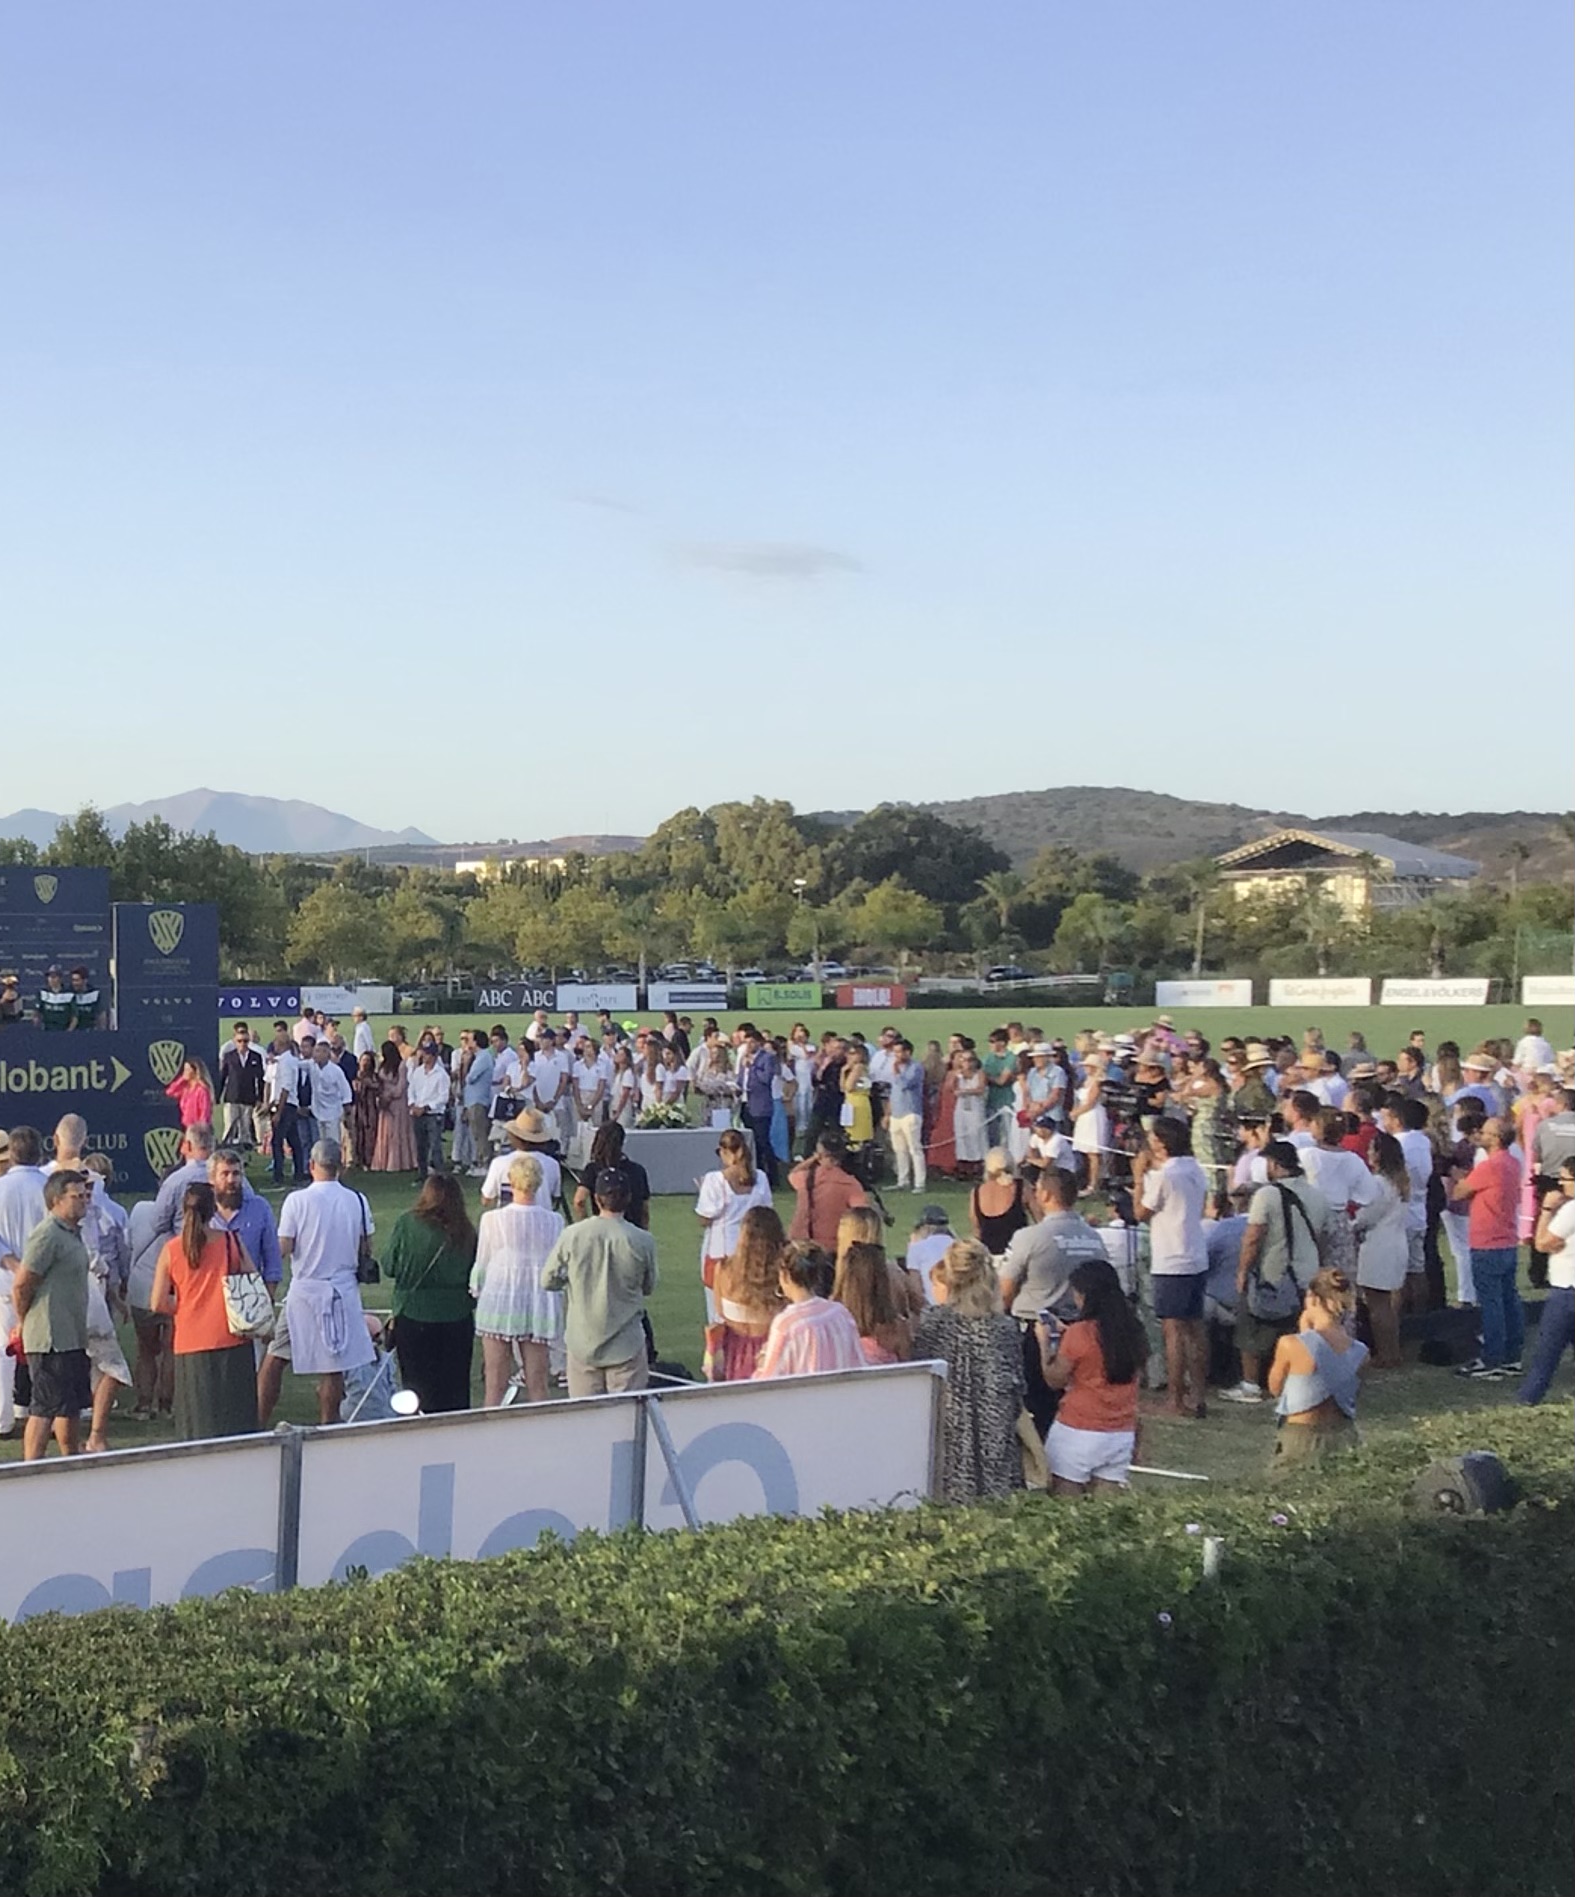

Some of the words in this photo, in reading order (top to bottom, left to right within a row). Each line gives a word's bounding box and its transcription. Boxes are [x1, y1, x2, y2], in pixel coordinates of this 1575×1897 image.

[477, 989, 513, 1007] ABC
[520, 989, 555, 1007] ABC
[86, 1133, 128, 1150] CLUB
